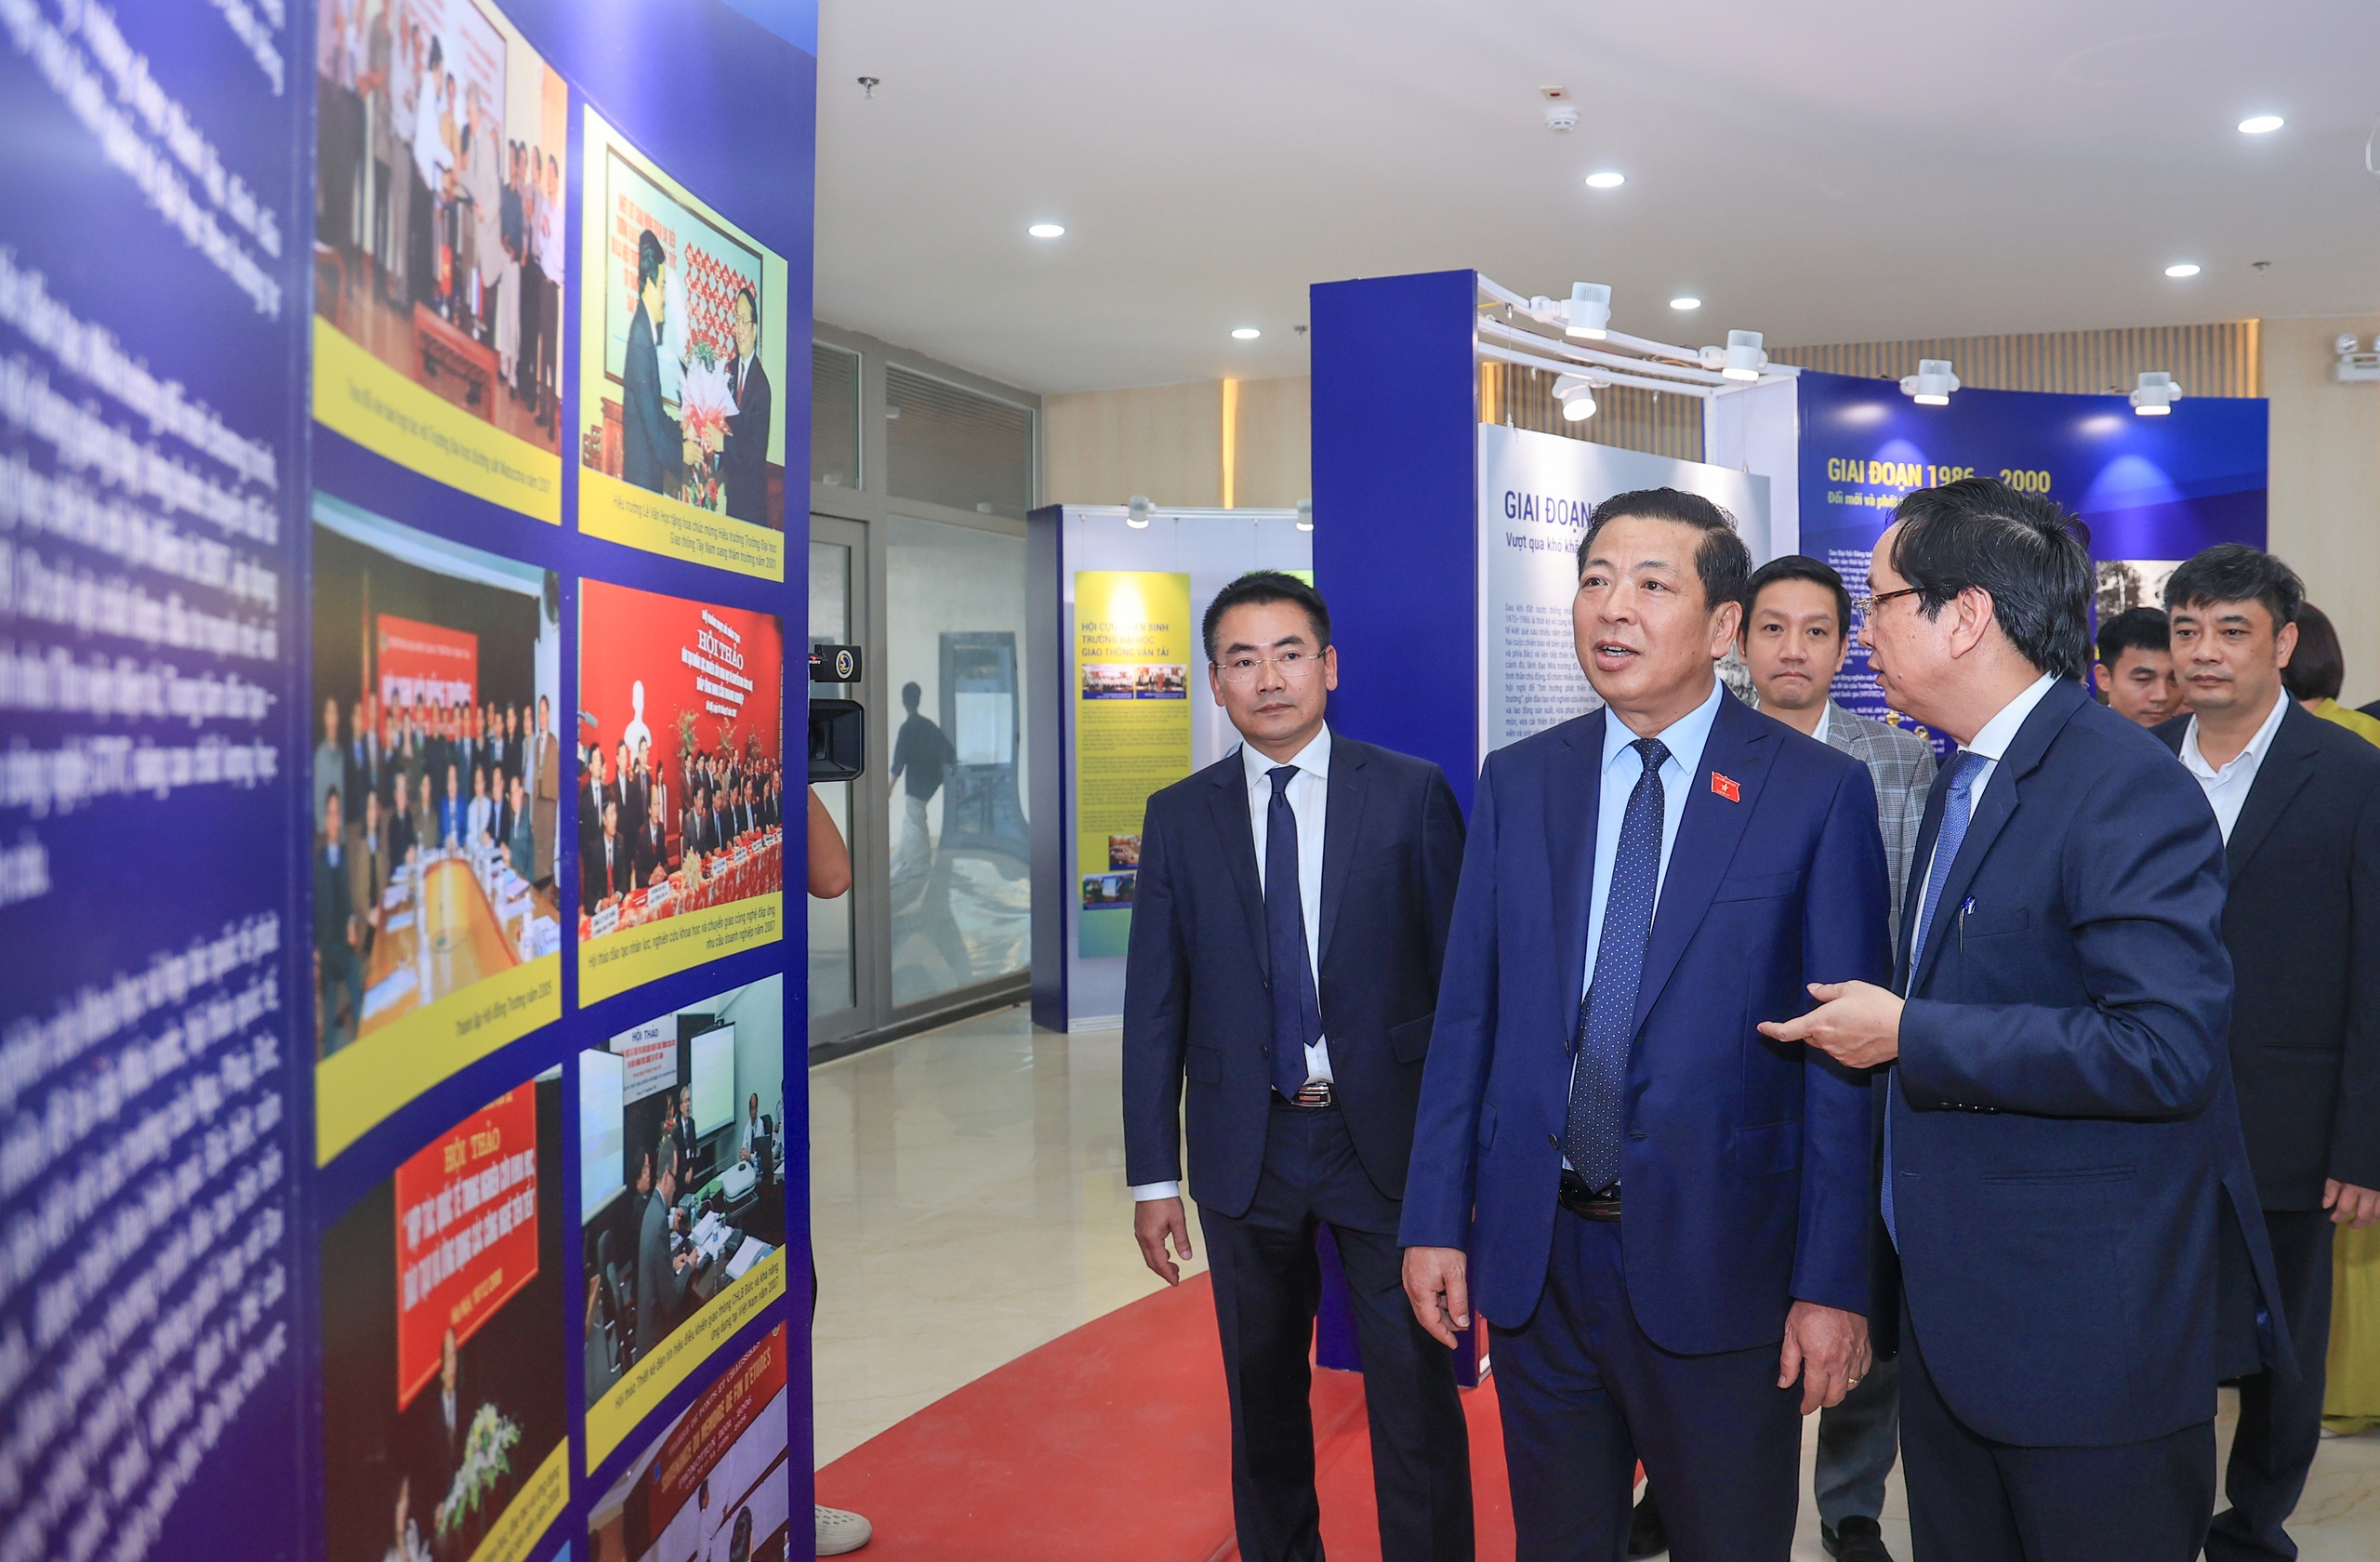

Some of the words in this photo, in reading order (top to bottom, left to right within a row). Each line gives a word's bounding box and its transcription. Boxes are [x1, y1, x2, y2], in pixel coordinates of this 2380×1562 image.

[1827, 457, 1864, 483] GIAI
[1868, 460, 1922, 492] ĐOẠN
[1999, 469, 2051, 493] 2000
[1863, 493, 1876, 507] và
[1504, 490, 1539, 522] GIAI
[1545, 496, 1592, 534] ĐOẠN
[1506, 531, 1527, 551] Vượt
[1528, 538, 1544, 553] qua
[1547, 536, 1562, 552] khó
[1565, 538, 1580, 554] khă
[1082, 621, 1096, 632] HỘI
[1099, 622, 1117, 632] CỰU
[1148, 623, 1169, 631] BINH
[697, 629, 719, 659] HỘI
[1082, 634, 1117, 643] TRƯỜNG
[1136, 635, 1155, 644] HỌC
[1081, 648, 1103, 656] GIAO
[1104, 646, 1135, 656] THÔNG
[1157, 646, 1170, 656] TẢI
